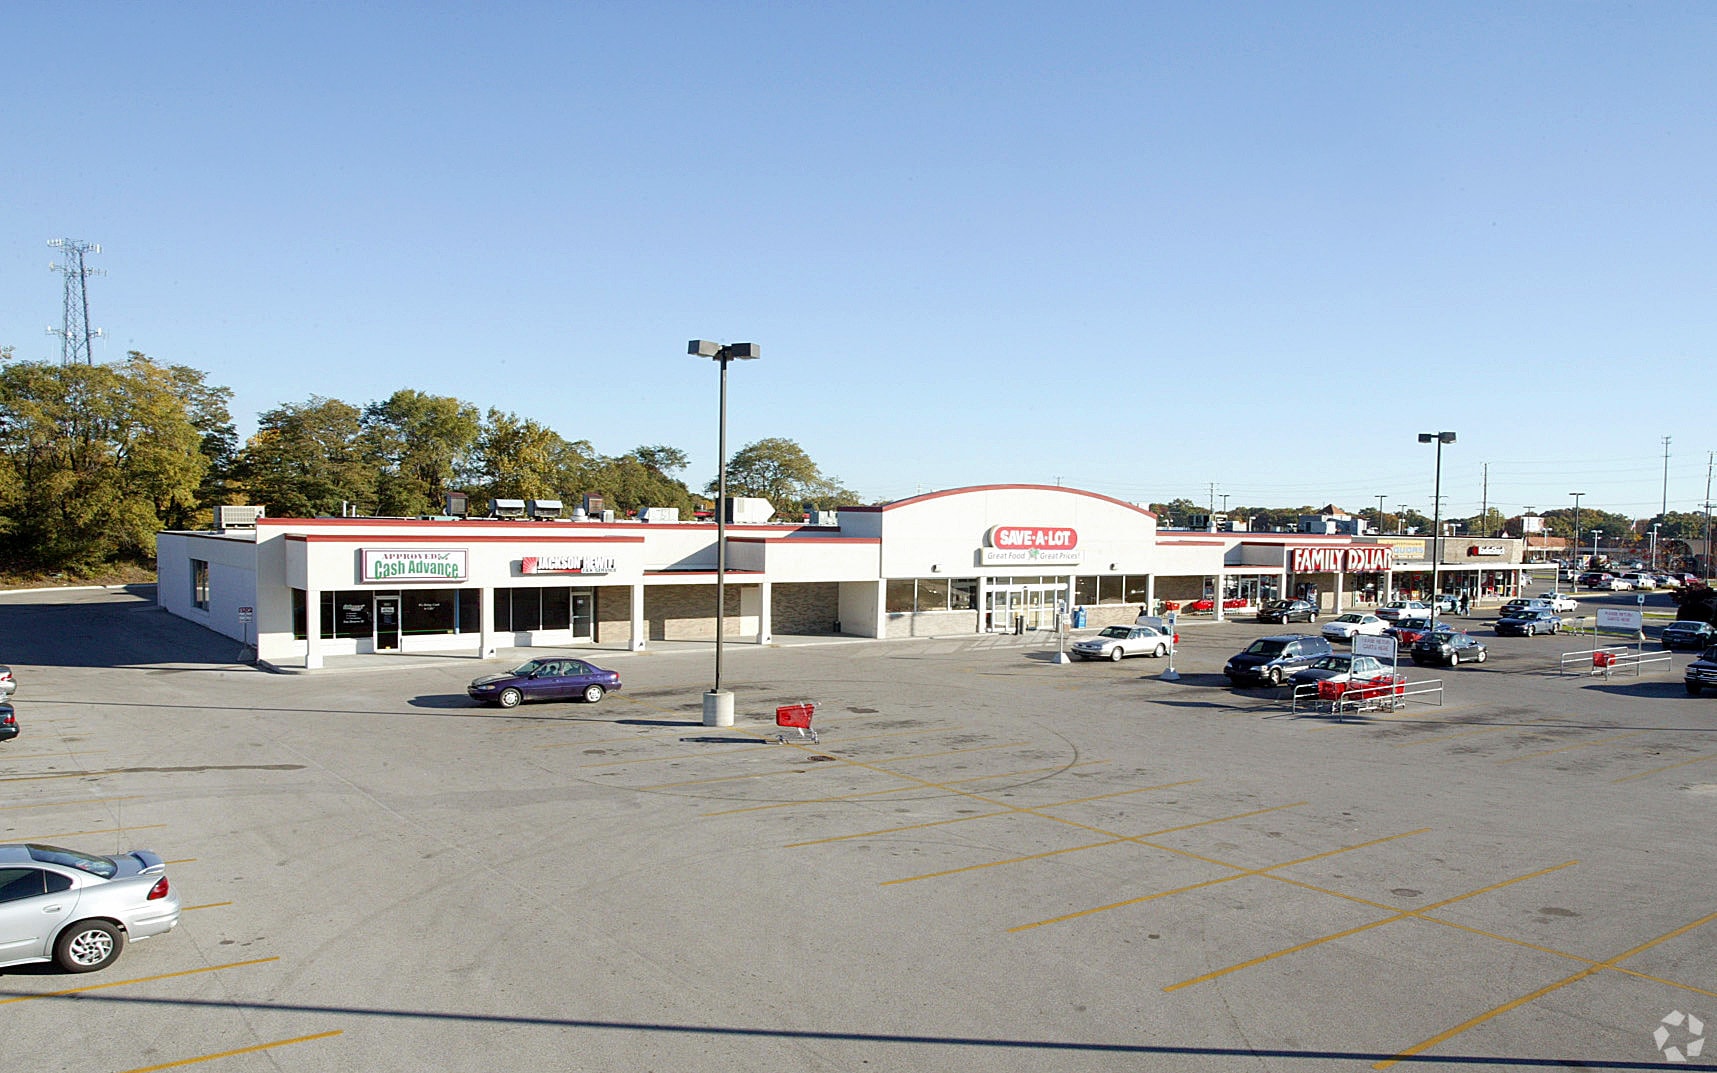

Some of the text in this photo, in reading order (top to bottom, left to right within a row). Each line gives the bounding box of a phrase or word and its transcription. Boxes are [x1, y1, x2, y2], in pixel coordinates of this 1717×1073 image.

[537, 556, 581, 569] JACKSON
[988, 552, 1007, 560] Great
[1008, 552, 1025, 560] Food
[1040, 552, 1058, 560] Great
[1294, 548, 1392, 571] FAMILY DOLLAR
[374, 560, 459, 580] Cash Advance
